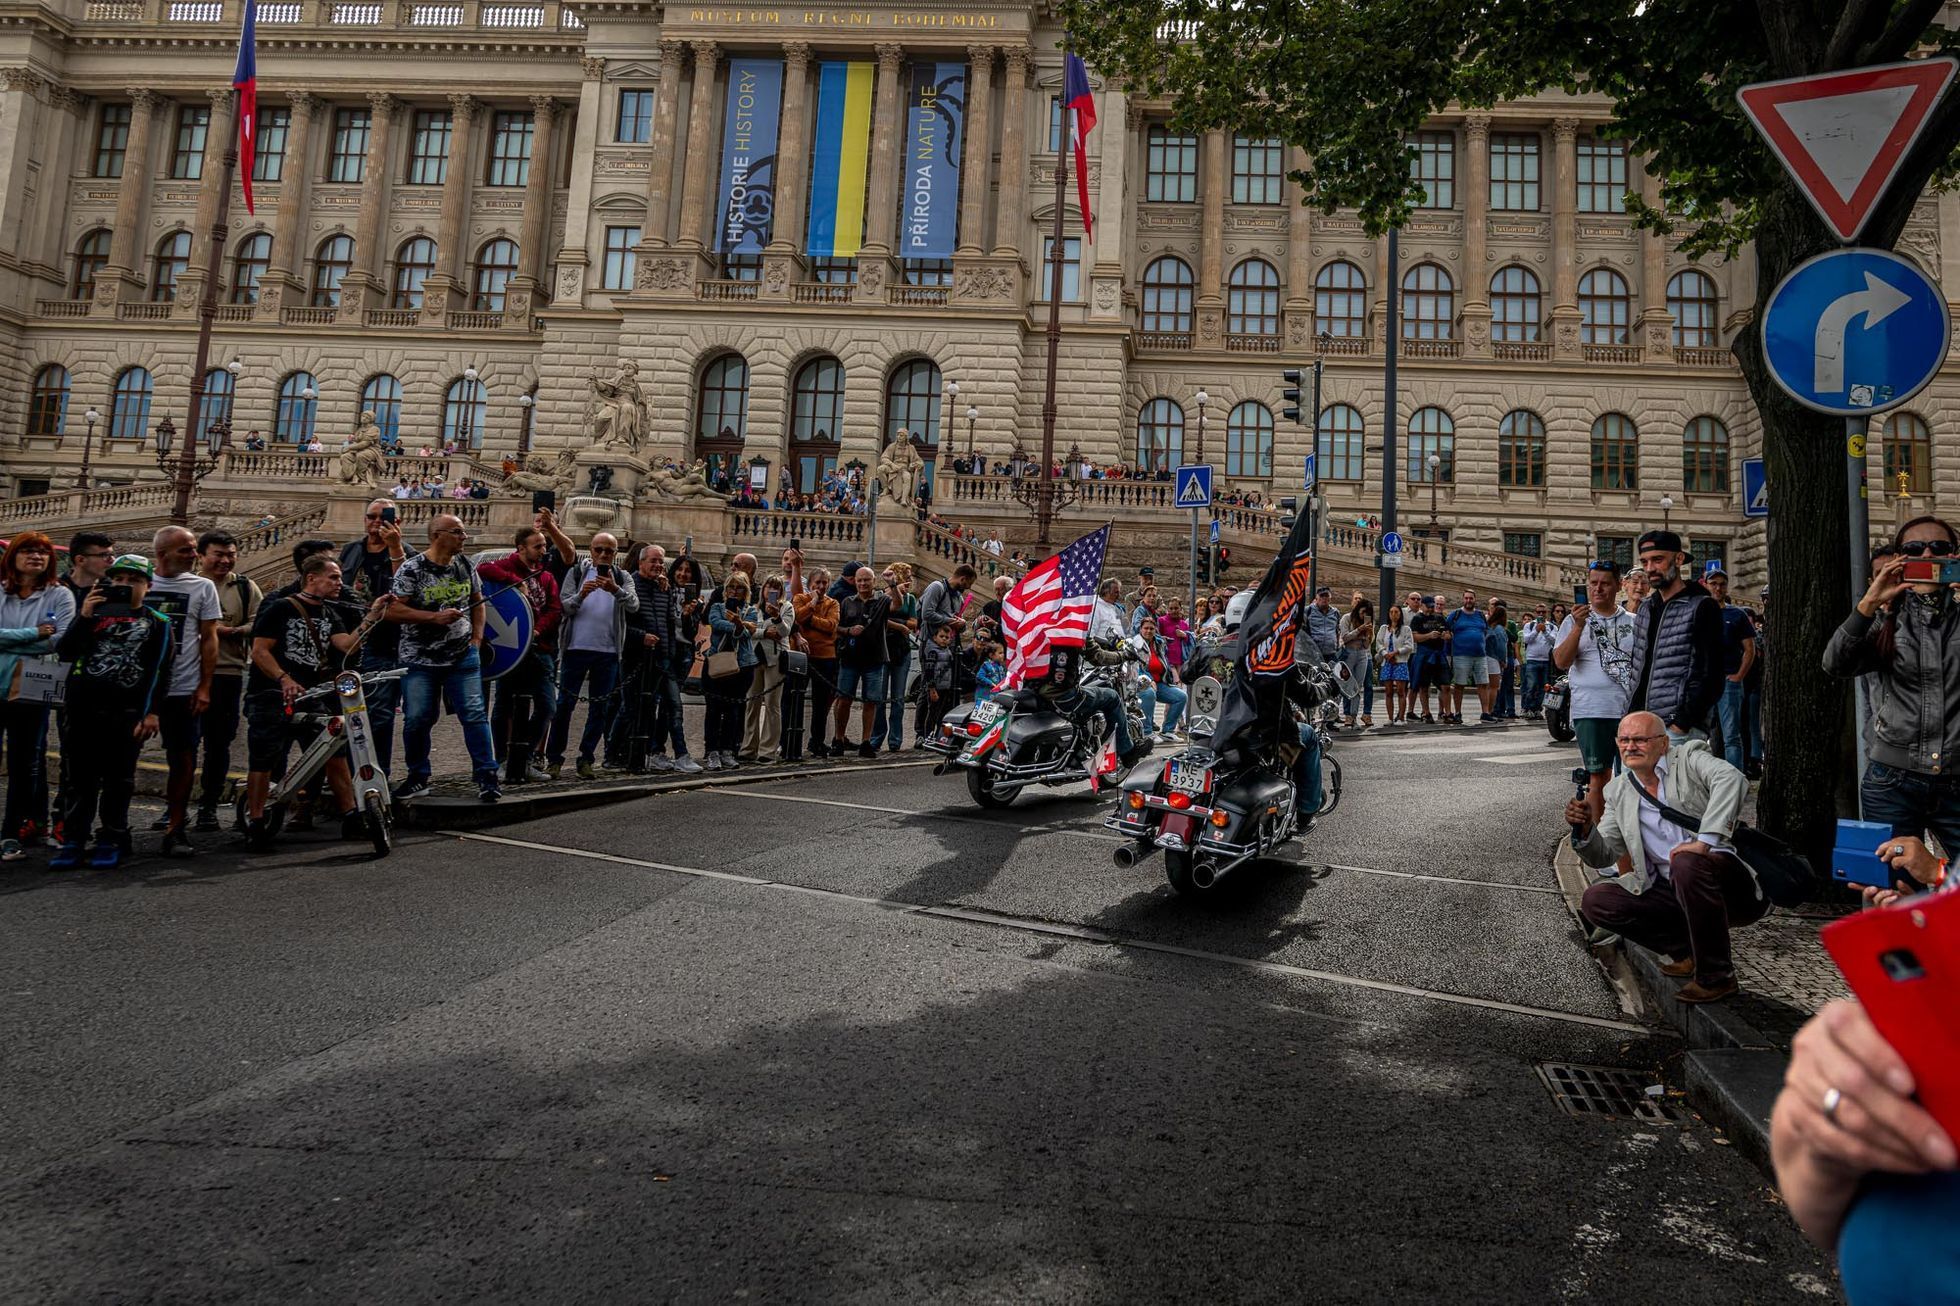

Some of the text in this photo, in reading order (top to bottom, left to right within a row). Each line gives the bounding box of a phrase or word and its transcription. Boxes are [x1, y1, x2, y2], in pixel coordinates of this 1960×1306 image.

[690, 9, 999, 28] MUSEUM REGNI BOHEMIAE
[726, 70, 757, 243] HISTORIE HISTORY
[908, 85, 937, 247] PŘÍRODA NATURE
[981, 702, 994, 713] NE
[972, 710, 994, 722] 3420
[1182, 761, 1200, 776] NE
[1172, 774, 1203, 790] 3937
